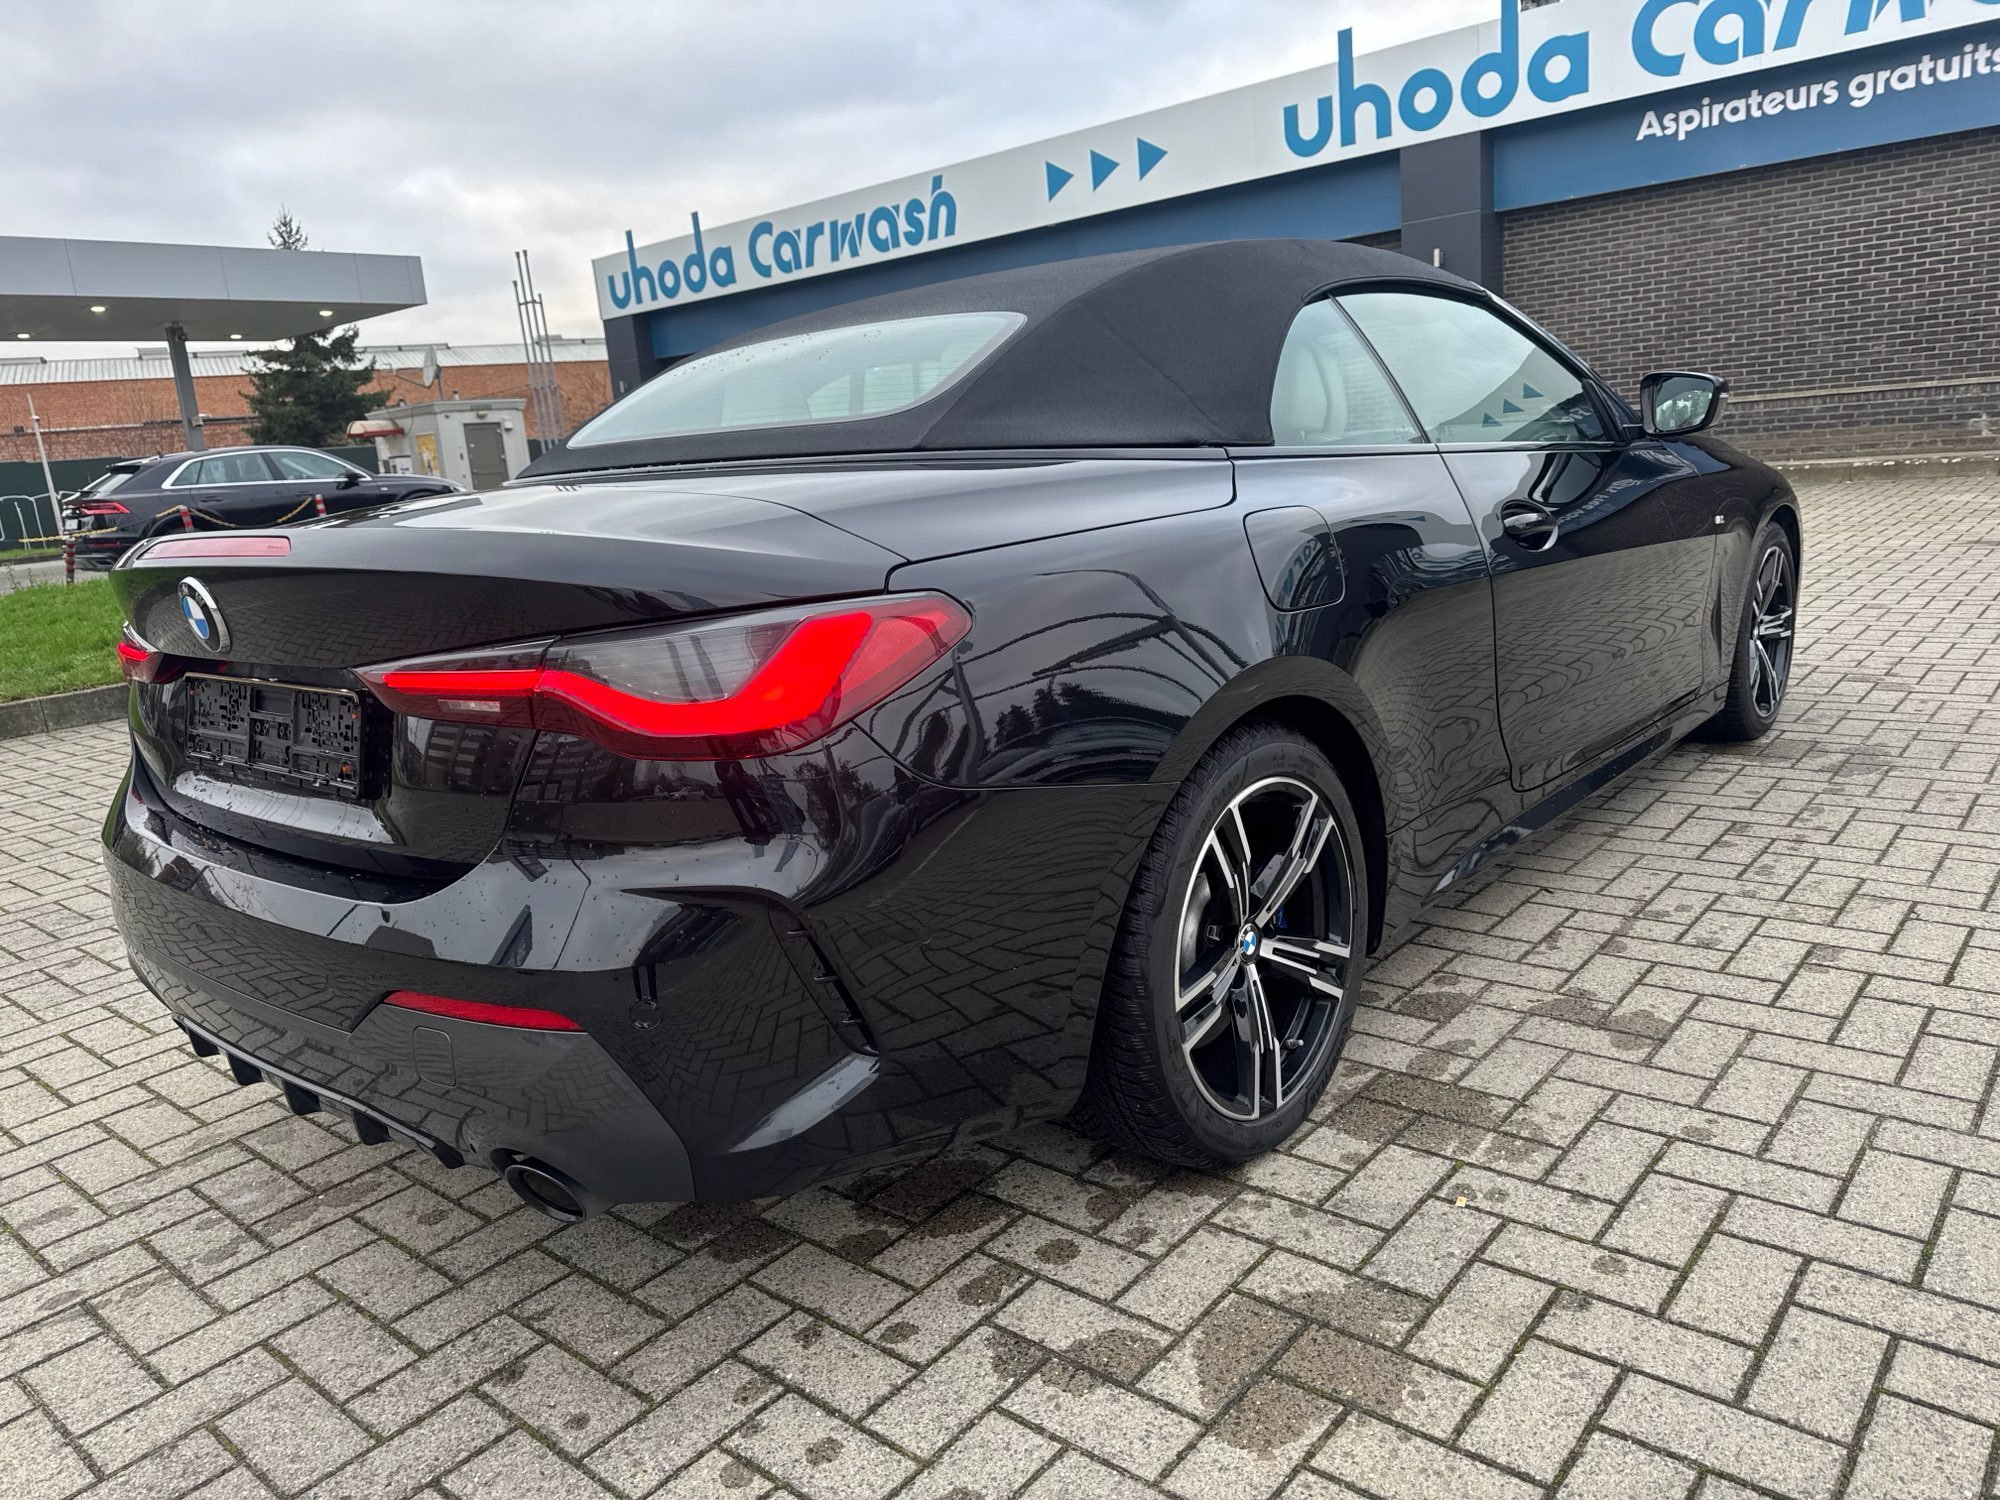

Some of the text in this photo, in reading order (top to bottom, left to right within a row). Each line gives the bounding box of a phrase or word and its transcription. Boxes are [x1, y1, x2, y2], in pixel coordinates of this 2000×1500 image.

[1283, 0, 1589, 158] uhoda
[1635, 80, 1839, 142] Aspirateurs
[607, 174, 957, 310] uhoda Carwash
